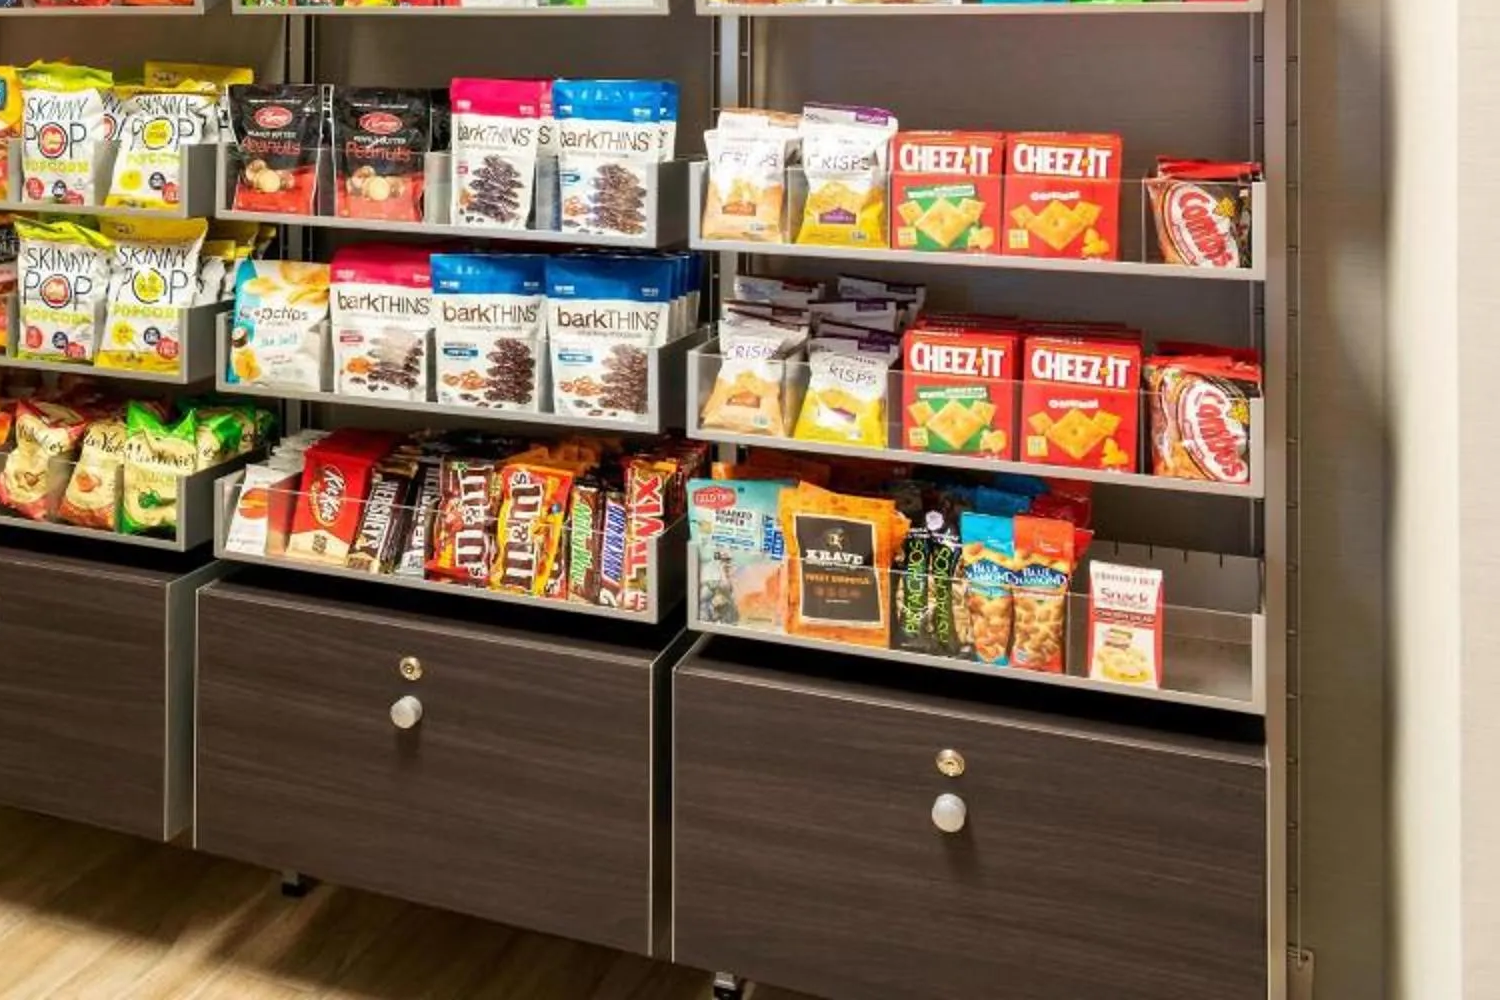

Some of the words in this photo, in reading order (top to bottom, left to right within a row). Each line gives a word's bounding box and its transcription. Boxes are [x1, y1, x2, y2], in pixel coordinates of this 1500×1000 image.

[26, 96, 89, 121] SKINNY
[24, 121, 88, 160] POP
[345, 142, 412, 162] Peanuts
[27, 248, 97, 274] SKINNY
[118, 246, 188, 268] SKINNY
[23, 269, 93, 311] POP
[116, 266, 189, 304] POP
[337, 290, 432, 317] barkTHINS
[443, 301, 540, 324] barkTHINS
[557, 307, 660, 333] barkTHINS
[829, 365, 877, 386] RISPS
[362, 480, 399, 549] HERSHEY'S
[805, 549, 864, 567] KRAVE
[904, 539, 926, 635] PISTACHIOS
